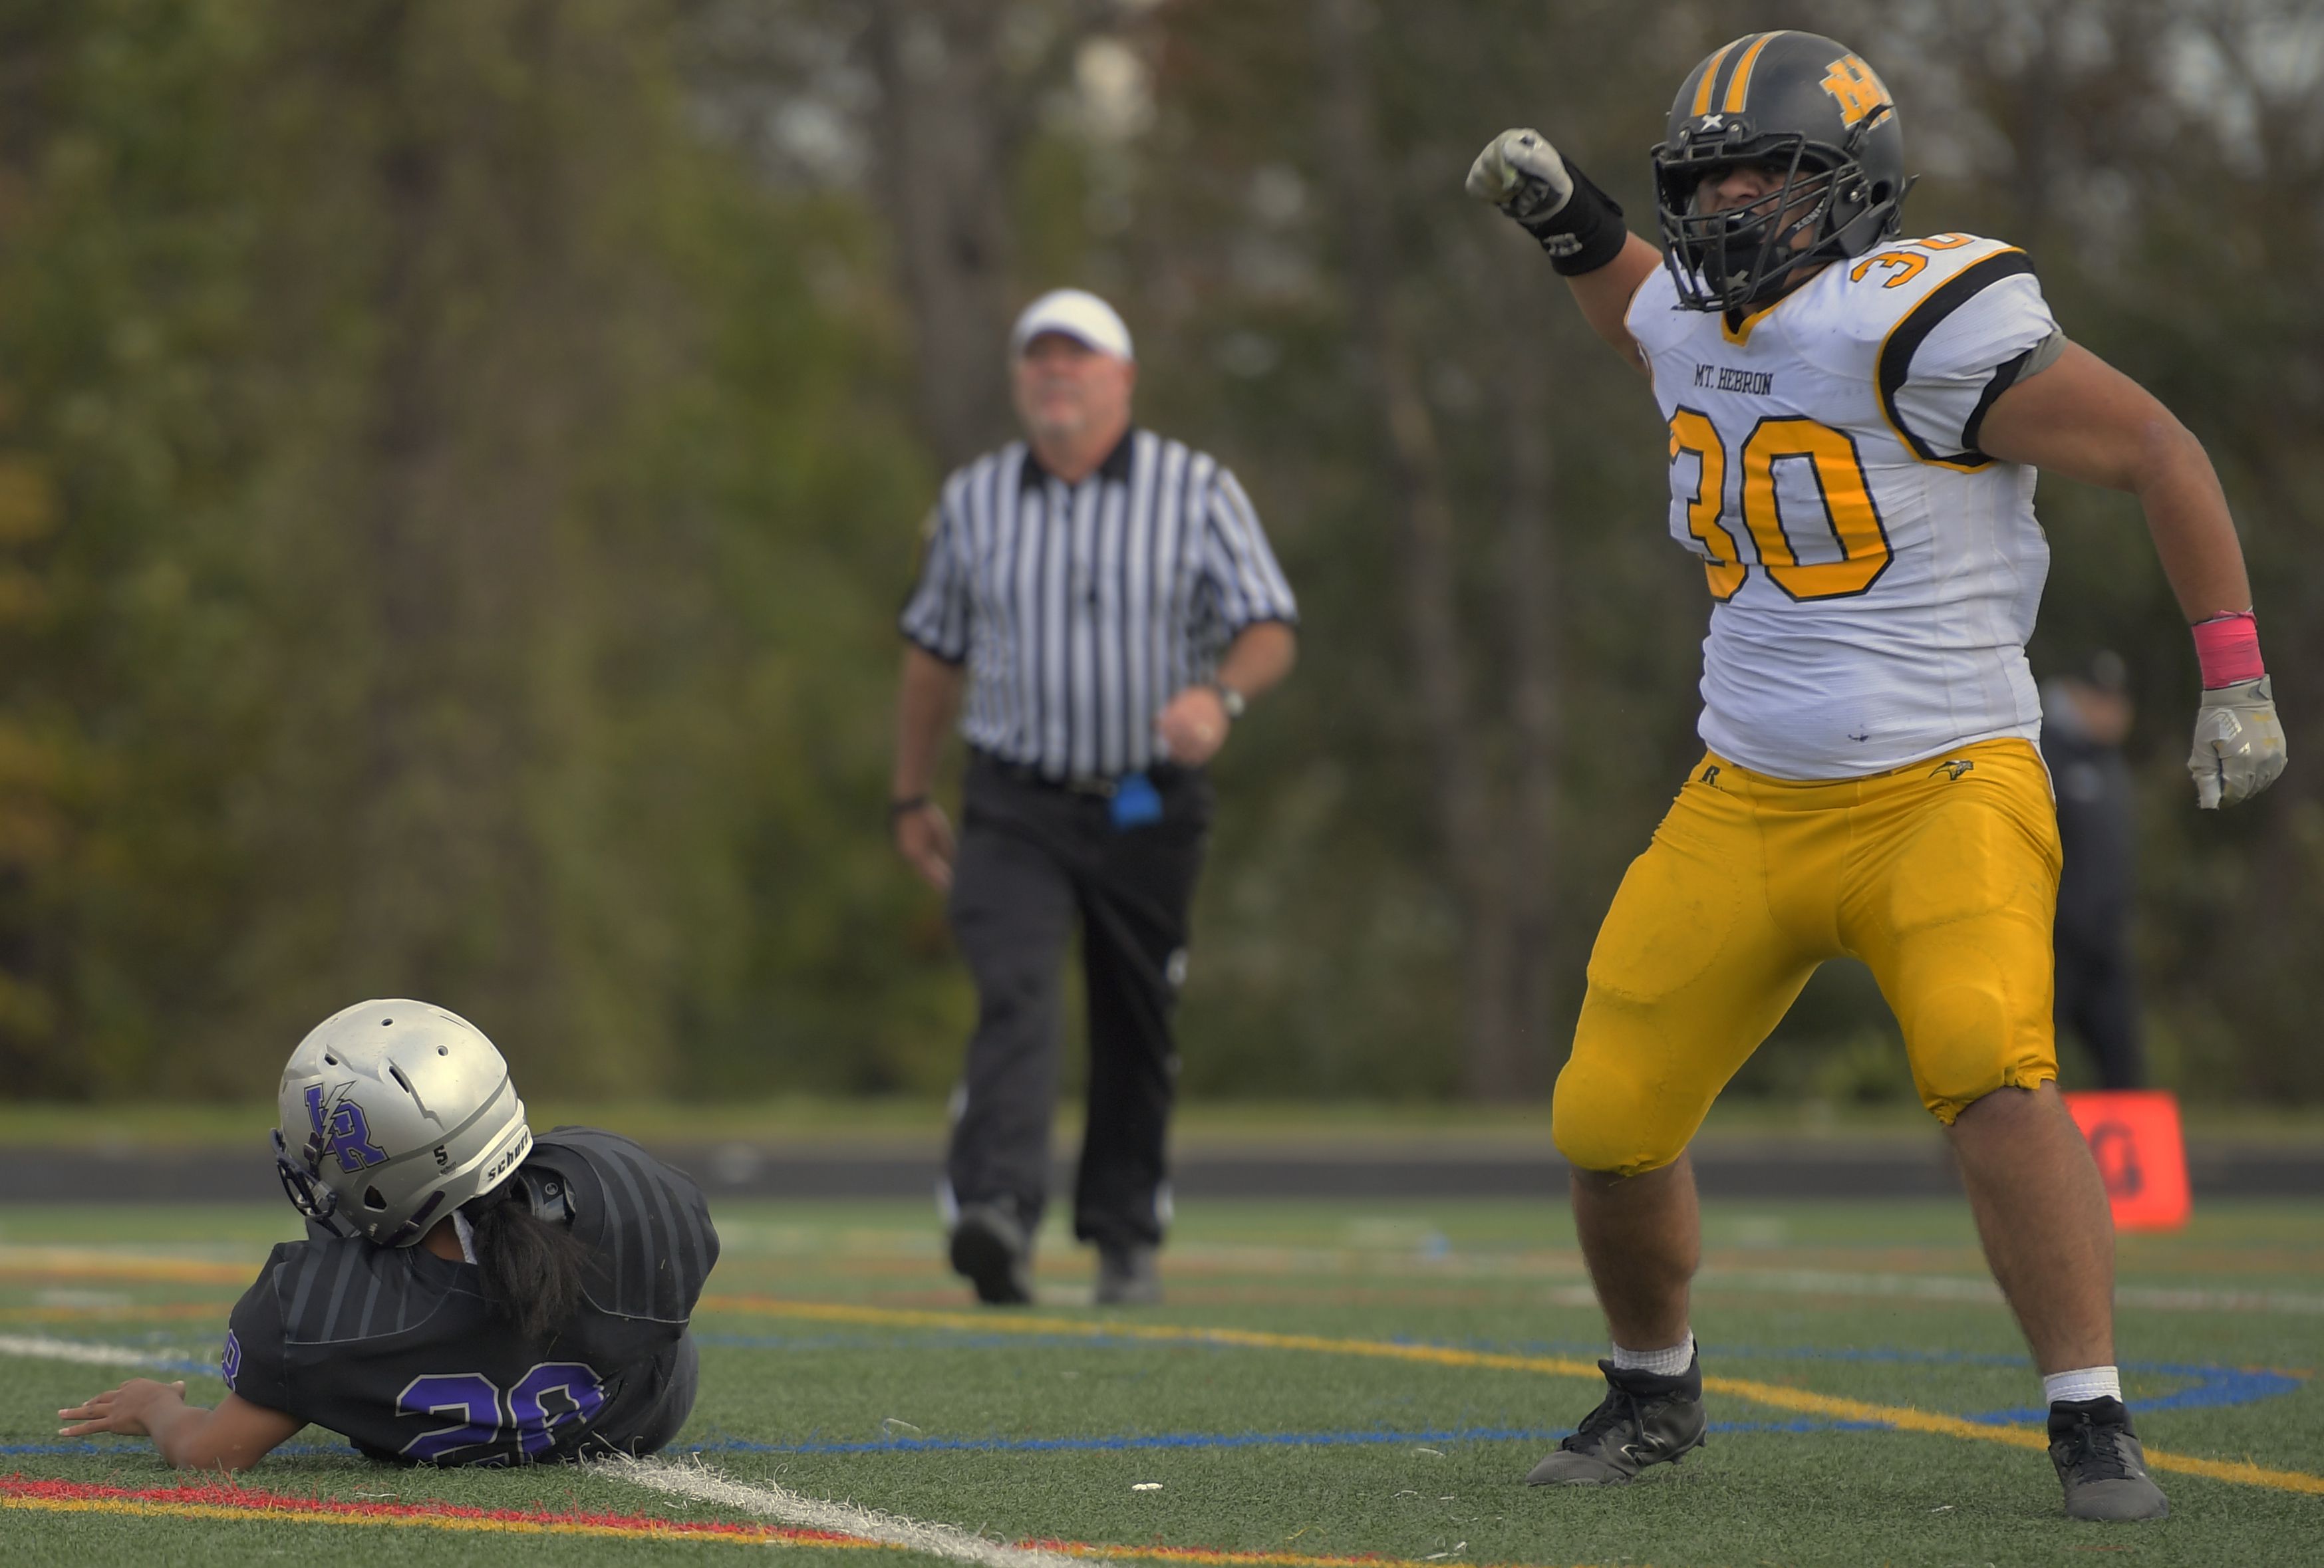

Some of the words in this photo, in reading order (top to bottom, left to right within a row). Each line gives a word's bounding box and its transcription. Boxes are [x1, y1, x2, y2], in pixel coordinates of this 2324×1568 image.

[1695, 363, 1714, 388] MT.
[1717, 367, 1774, 395] HEBRON
[1668, 404, 1894, 603] 30
